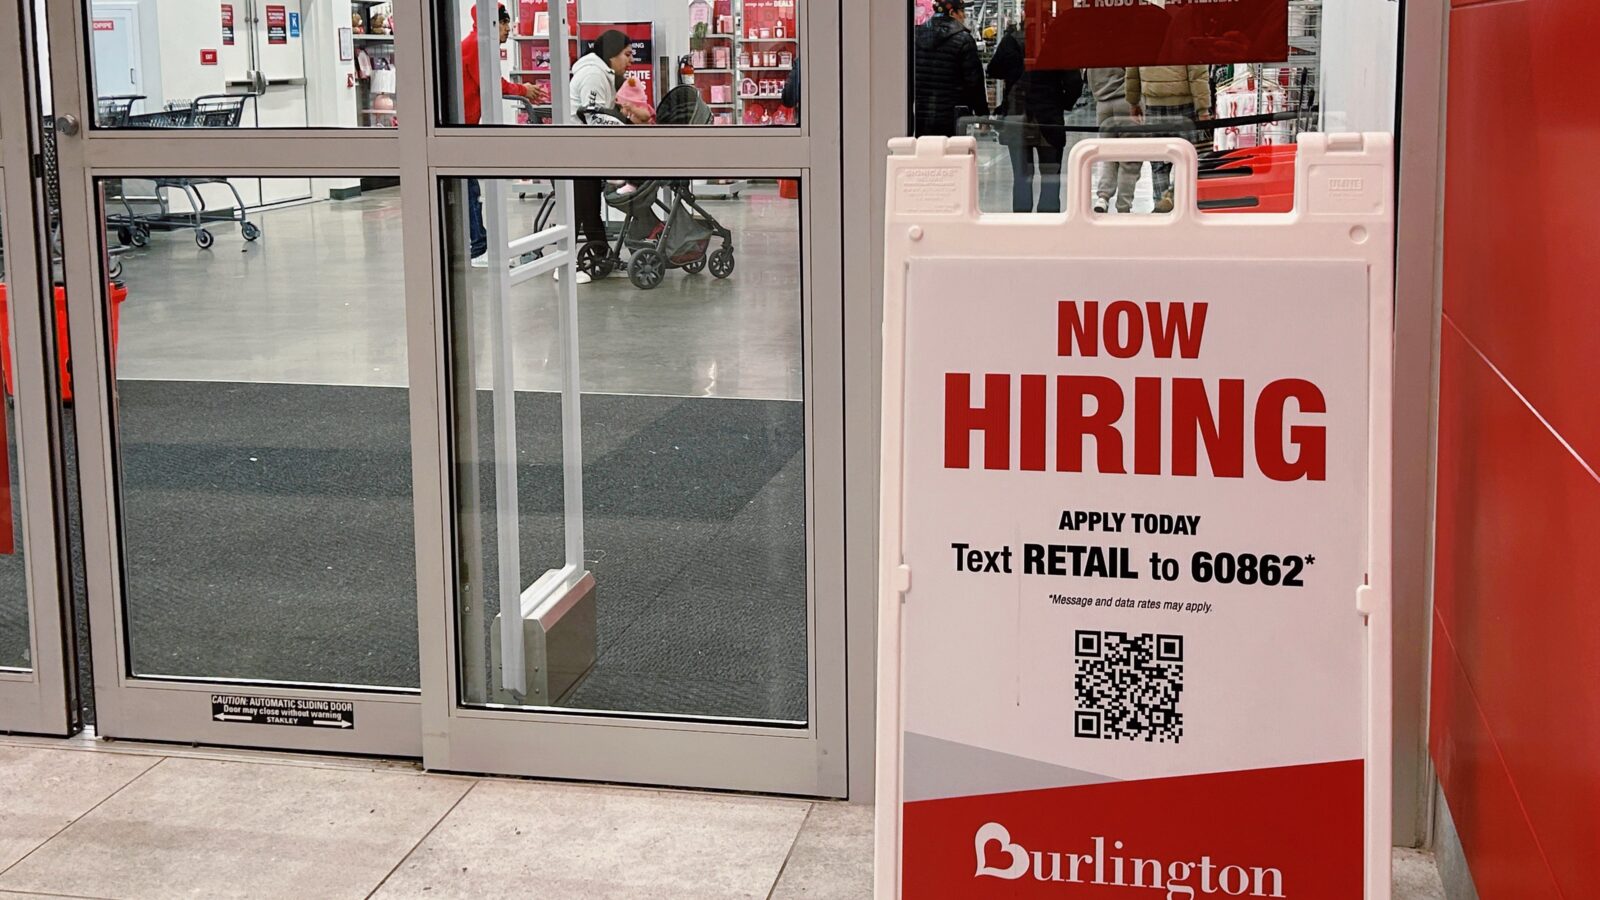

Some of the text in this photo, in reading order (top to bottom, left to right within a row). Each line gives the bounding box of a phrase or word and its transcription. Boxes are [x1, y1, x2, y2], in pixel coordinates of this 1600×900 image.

[1057, 300, 1209, 359] NOW
[944, 372, 1327, 482] HIRING
[1058, 511, 1201, 536] APPLY TODAY
[951, 542, 1012, 574] Text
[1023, 543, 1139, 579] RETAIL
[1149, 552, 1180, 581] to
[1095, 595, 1112, 607] and
[1114, 597, 1135, 608] data
[1137, 598, 1161, 609] rates
[1163, 601, 1183, 613] may
[1185, 601, 1213, 614] apply.
[212, 695, 353, 712] CAUTION: AUTOMATIC SLIDING DOOR
[223, 704, 342, 721] Door may close without warning
[266, 716, 299, 725] STANLEY
[974, 821, 1287, 900] Burlington
